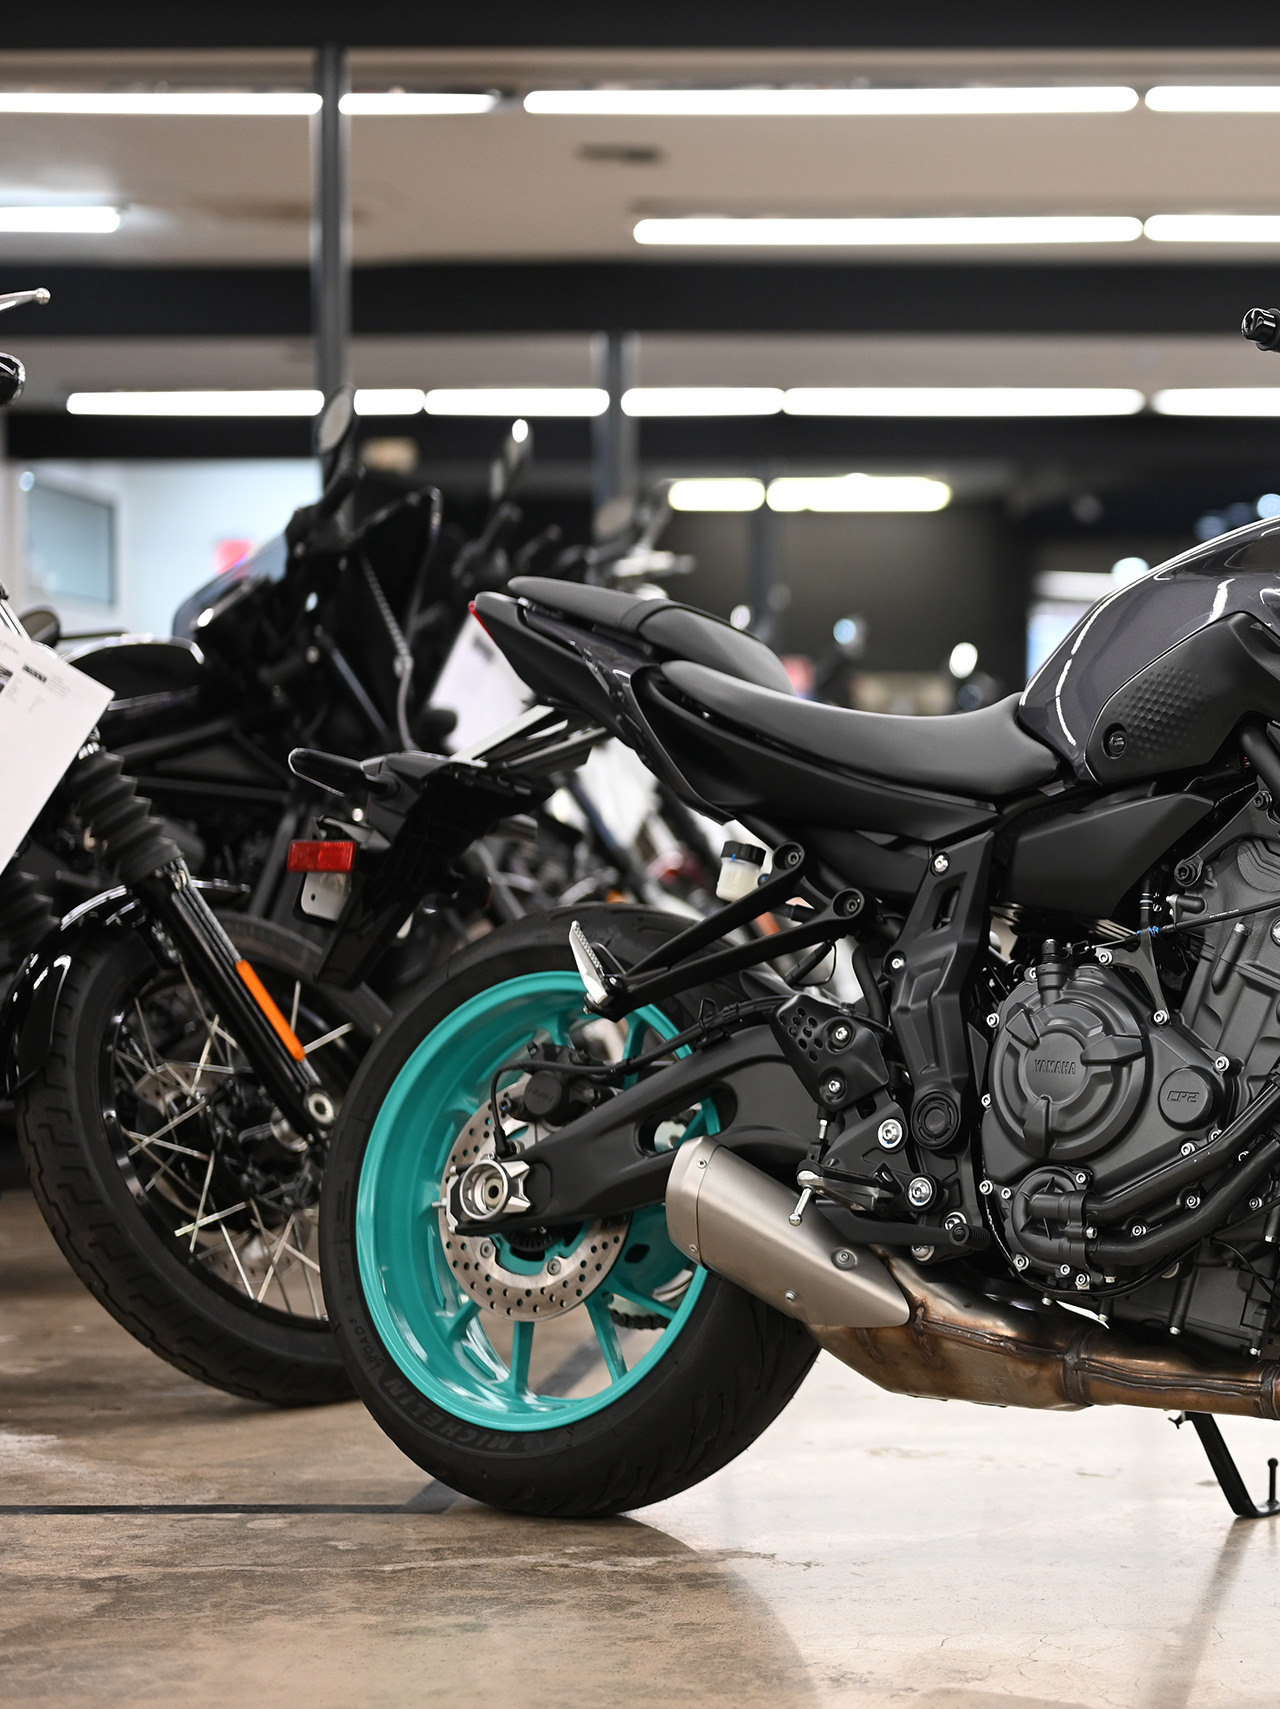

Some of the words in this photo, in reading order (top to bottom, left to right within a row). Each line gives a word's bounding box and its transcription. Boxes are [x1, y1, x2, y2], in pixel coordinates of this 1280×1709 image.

[1033, 1058, 1077, 1075] YAMAHA
[1166, 1090, 1200, 1103] CP2
[354, 1326, 378, 1364] ROAD
[384, 1377, 514, 1451] MICHELIN
